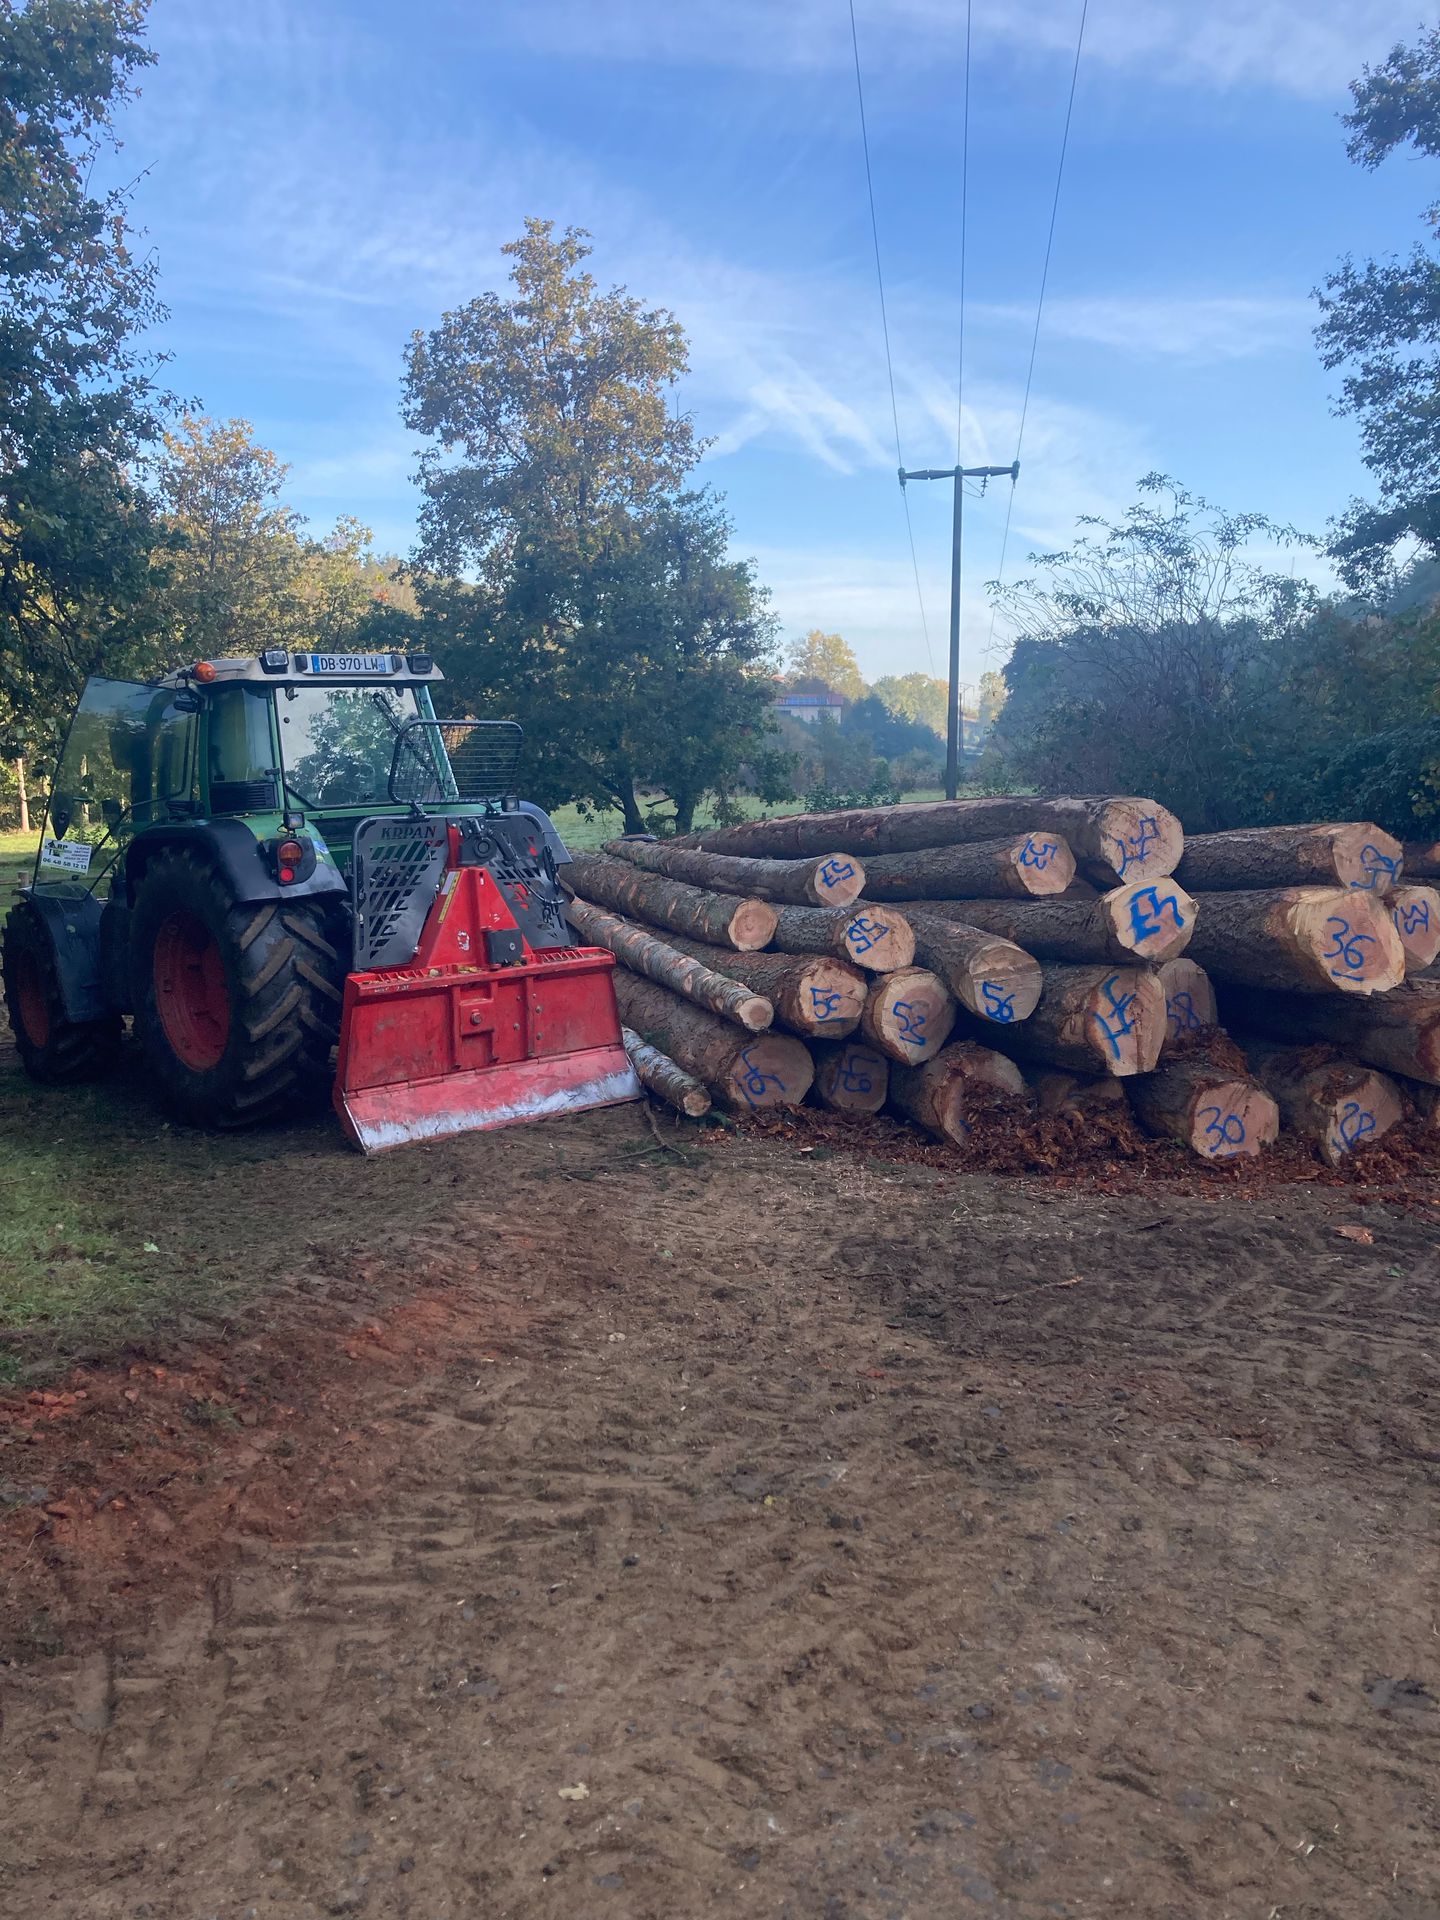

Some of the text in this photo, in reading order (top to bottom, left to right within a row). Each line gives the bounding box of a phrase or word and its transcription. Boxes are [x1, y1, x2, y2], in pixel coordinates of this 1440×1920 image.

[819, 859, 855, 888] 57
[1020, 841, 1057, 870] 53
[1322, 916, 1376, 970] 36
[892, 1000, 927, 1047] 52
[981, 981, 1015, 1025] 56
[1199, 1106, 1246, 1153] 30
